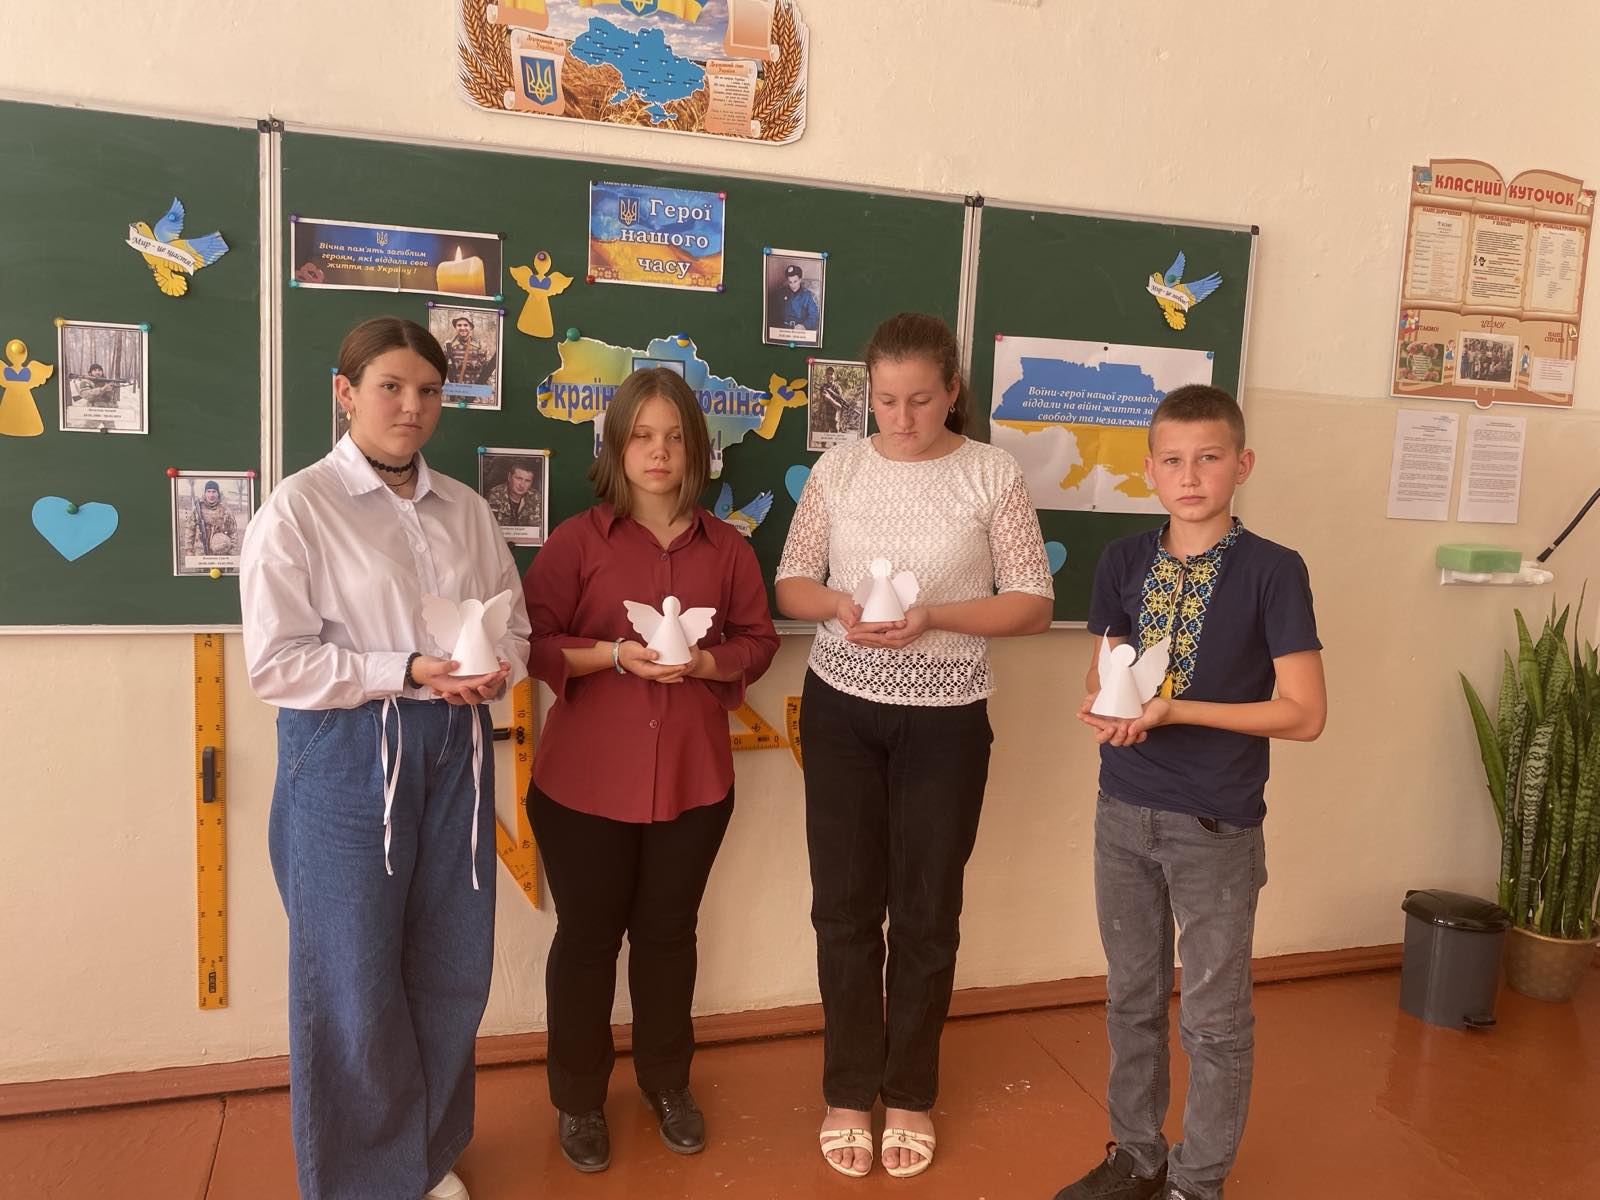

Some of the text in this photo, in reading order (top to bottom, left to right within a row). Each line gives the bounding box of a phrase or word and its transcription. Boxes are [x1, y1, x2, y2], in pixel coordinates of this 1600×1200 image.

[1435, 175, 1575, 206] КЛАСНИЙ КУТОЧОК
[649, 198, 713, 223] Герої
[620, 228, 708, 248] нашого
[132, 236, 151, 249] Мир
[157, 245, 167, 253] це
[167, 250, 195, 268] щастя!
[319, 242, 345, 251] Вічна
[386, 249, 427, 258] загиблим
[322, 253, 355, 262] героям,
[374, 256, 407, 265] віддали
[637, 258, 691, 278] часу
[1028, 386, 1086, 400] Воїни-герої
[1117, 394, 1160, 404] громади,
[1022, 399, 1060, 409] віддали
[1063, 402, 1075, 410] на
[1077, 401, 1101, 411] війні
[1102, 405, 1141, 414] життя
[1038, 412, 1151, 427] свободу та незалежніс
[517, 709, 526, 718] 10
[519, 752, 527, 762] 20
[522, 839, 530, 849] 40
